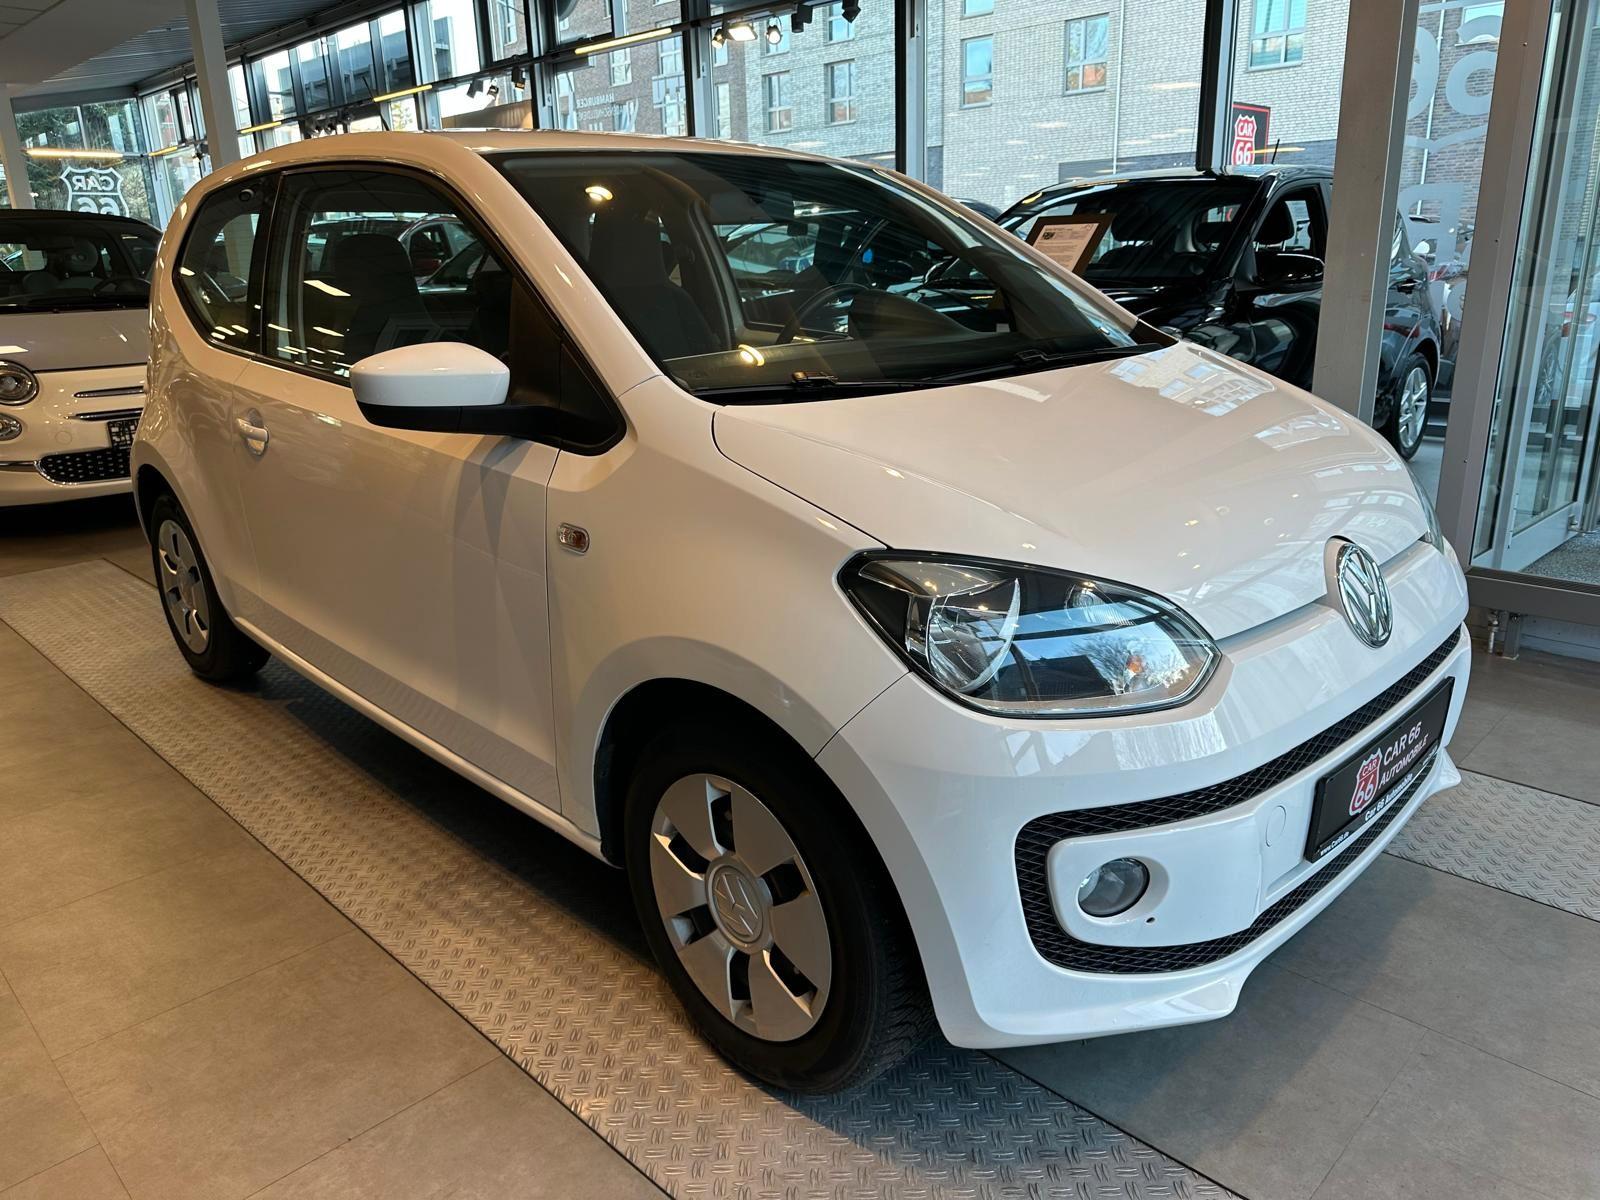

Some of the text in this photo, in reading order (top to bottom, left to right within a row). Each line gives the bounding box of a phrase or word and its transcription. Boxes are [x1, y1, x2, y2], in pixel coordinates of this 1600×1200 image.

[1237, 121, 1254, 137] CAR
[1235, 141, 1252, 165] 66
[1383, 732, 1409, 766] CAR
[1408, 721, 1422, 745] 66
[1362, 759, 1377, 777] CAR
[1378, 733, 1429, 790] AUTOMOBILE
[1354, 774, 1375, 808] 66
